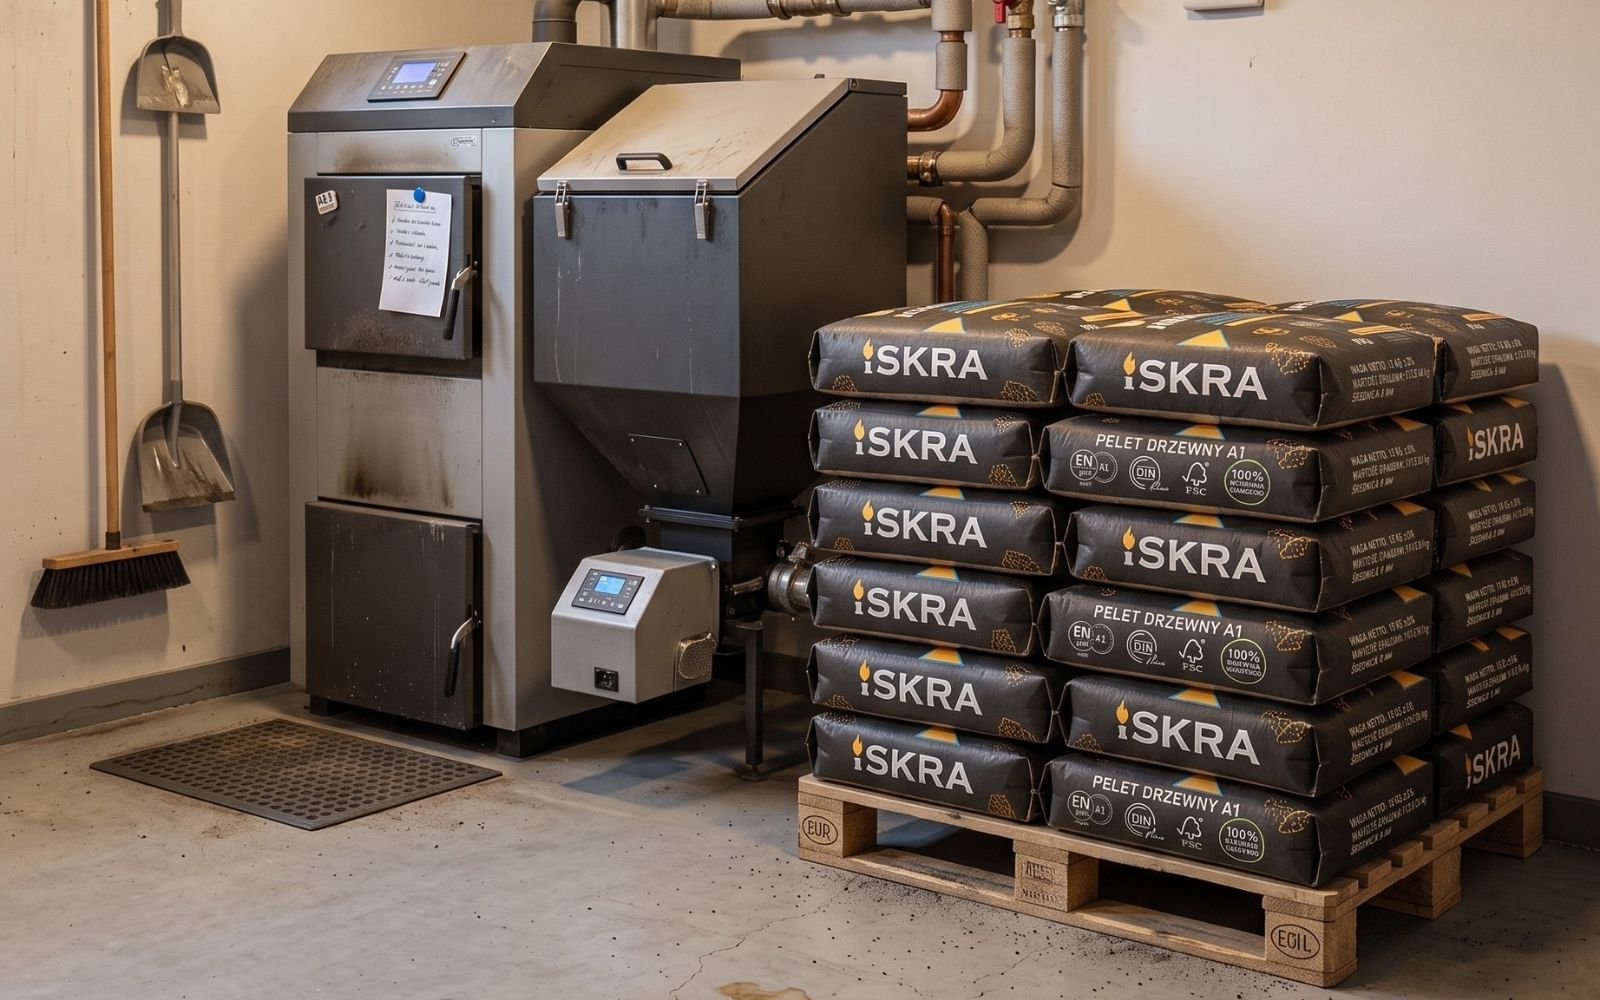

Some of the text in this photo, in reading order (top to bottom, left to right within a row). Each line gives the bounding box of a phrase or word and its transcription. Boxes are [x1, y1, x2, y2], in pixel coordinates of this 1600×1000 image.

[1095, 434, 1245, 460] PELET DRZEWNY A1
[1075, 454, 1093, 467] EN
[1136, 467, 1156, 479] DIN
[1231, 469, 1264, 482] 100%
[1094, 604, 1243, 638] PELET DRZEWNY A1
[1073, 625, 1091, 639] EN
[1134, 642, 1153, 653] DIN
[1229, 648, 1260, 663] 100%
[1072, 795, 1089, 810] EN
[1092, 775, 1241, 818] PELET DRZEWNY A1
[1132, 813, 1151, 826] DIN
[808, 820, 831, 841] EUR
[1227, 827, 1258, 842] 100%
